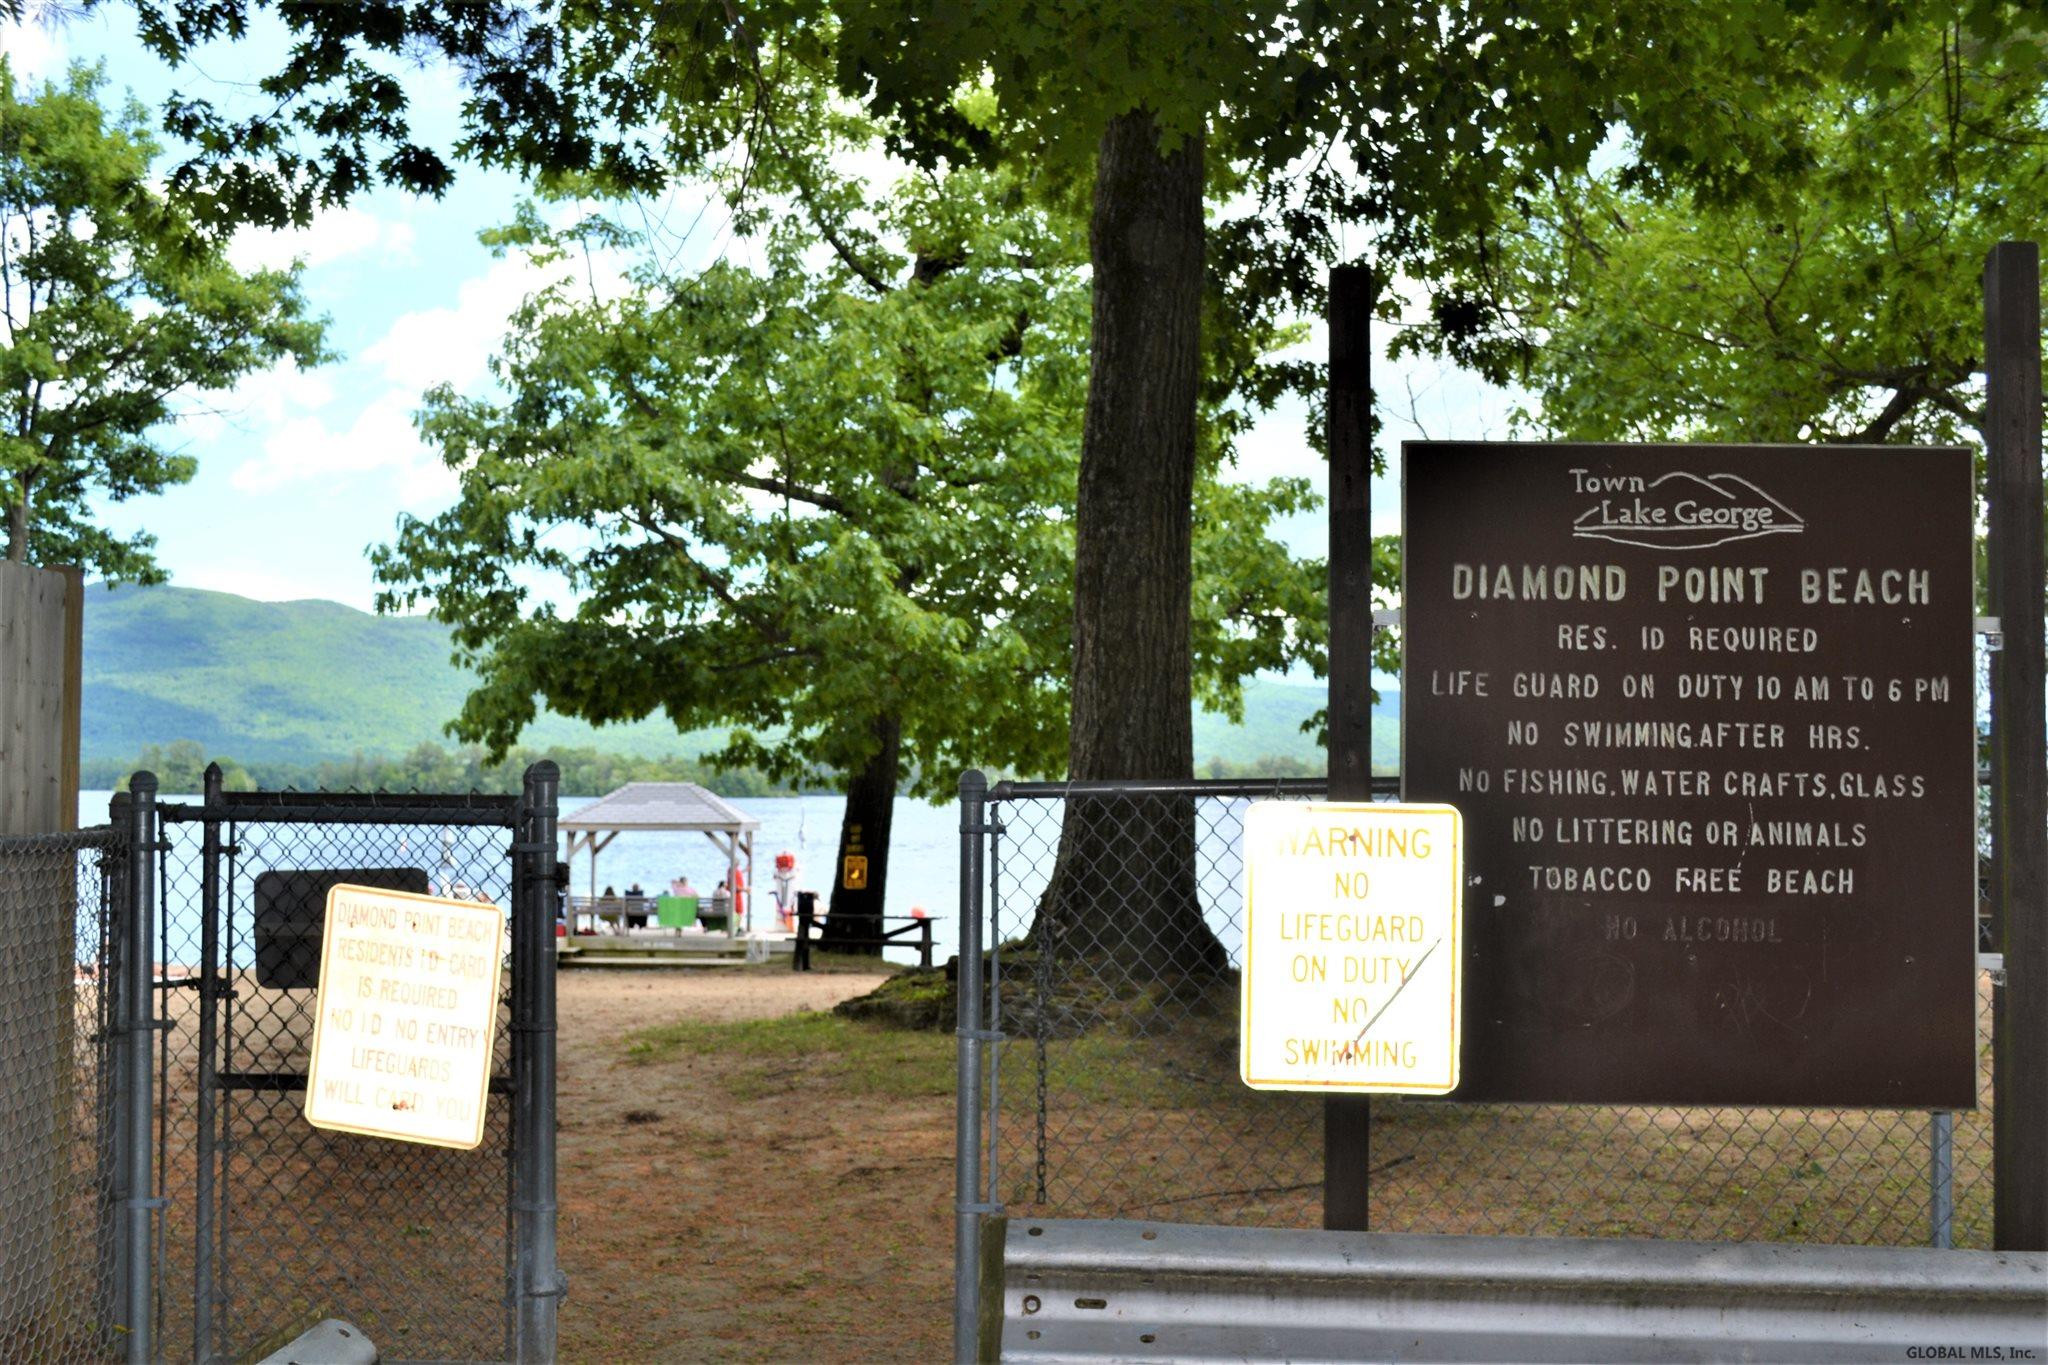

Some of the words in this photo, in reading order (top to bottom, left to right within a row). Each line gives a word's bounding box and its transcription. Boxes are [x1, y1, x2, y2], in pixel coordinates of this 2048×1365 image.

[1569, 469, 1645, 494] Town
[1602, 502, 1666, 525] Lake
[1675, 501, 1773, 530] George
[1453, 564, 1626, 601] DIAMOND
[1658, 565, 1769, 604] POINT
[1801, 567, 1929, 605] BEACH
[1558, 624, 1616, 650] RES.
[1642, 626, 1664, 650] ID
[1690, 627, 1817, 652] REQUIRED
[1431, 671, 1489, 697] LIFE
[1514, 672, 1598, 699] GUARD
[1623, 674, 1654, 699] ON
[1679, 673, 1742, 700] DUTY
[1758, 675, 1781, 700] 10
[1794, 676, 1829, 701] AM
[1843, 676, 1874, 701] TO
[1888, 679, 1901, 702] 6
[1915, 676, 1949, 702] PM
[1508, 720, 1538, 745] NO
[1810, 724, 1869, 750] HRS.
[1459, 768, 1489, 792] NO
[1840, 774, 1925, 798] GLASS
[1513, 817, 1543, 842] NO
[1557, 817, 1692, 846] LITTERING
[1706, 821, 1737, 847] OR
[1750, 821, 1867, 847] ANIMALS
[1335, 872, 1369, 900] NO
[1529, 866, 1651, 892] TOBACCO
[1676, 867, 1741, 893] FREE
[1767, 868, 1853, 894] BEACH
[338, 902, 396, 929] DIAMOND
[405, 911, 441, 934] POINT
[448, 916, 492, 942] BEACH
[1281, 913, 1424, 943] LIFEGUARD
[1663, 918, 1783, 943] ALCOHOL
[338, 938, 412, 968] RESIDENTS
[450, 952, 486, 979] CARD
[1292, 955, 1326, 983] ON
[1344, 956, 1410, 985] DUTY
[358, 976, 372, 997] IS
[380, 978, 458, 1010] REQUIRED
[1333, 998, 1367, 1024] NO
[332, 1008, 352, 1030] NO
[396, 1018, 417, 1040] NO
[427, 1022, 479, 1049] ENTRY
[352, 1048, 450, 1082] LIFEGUARDS
[1284, 1039, 1417, 1068] SWIMMING
[324, 1080, 364, 1105] WILL
[436, 1096, 470, 1121] YOU
